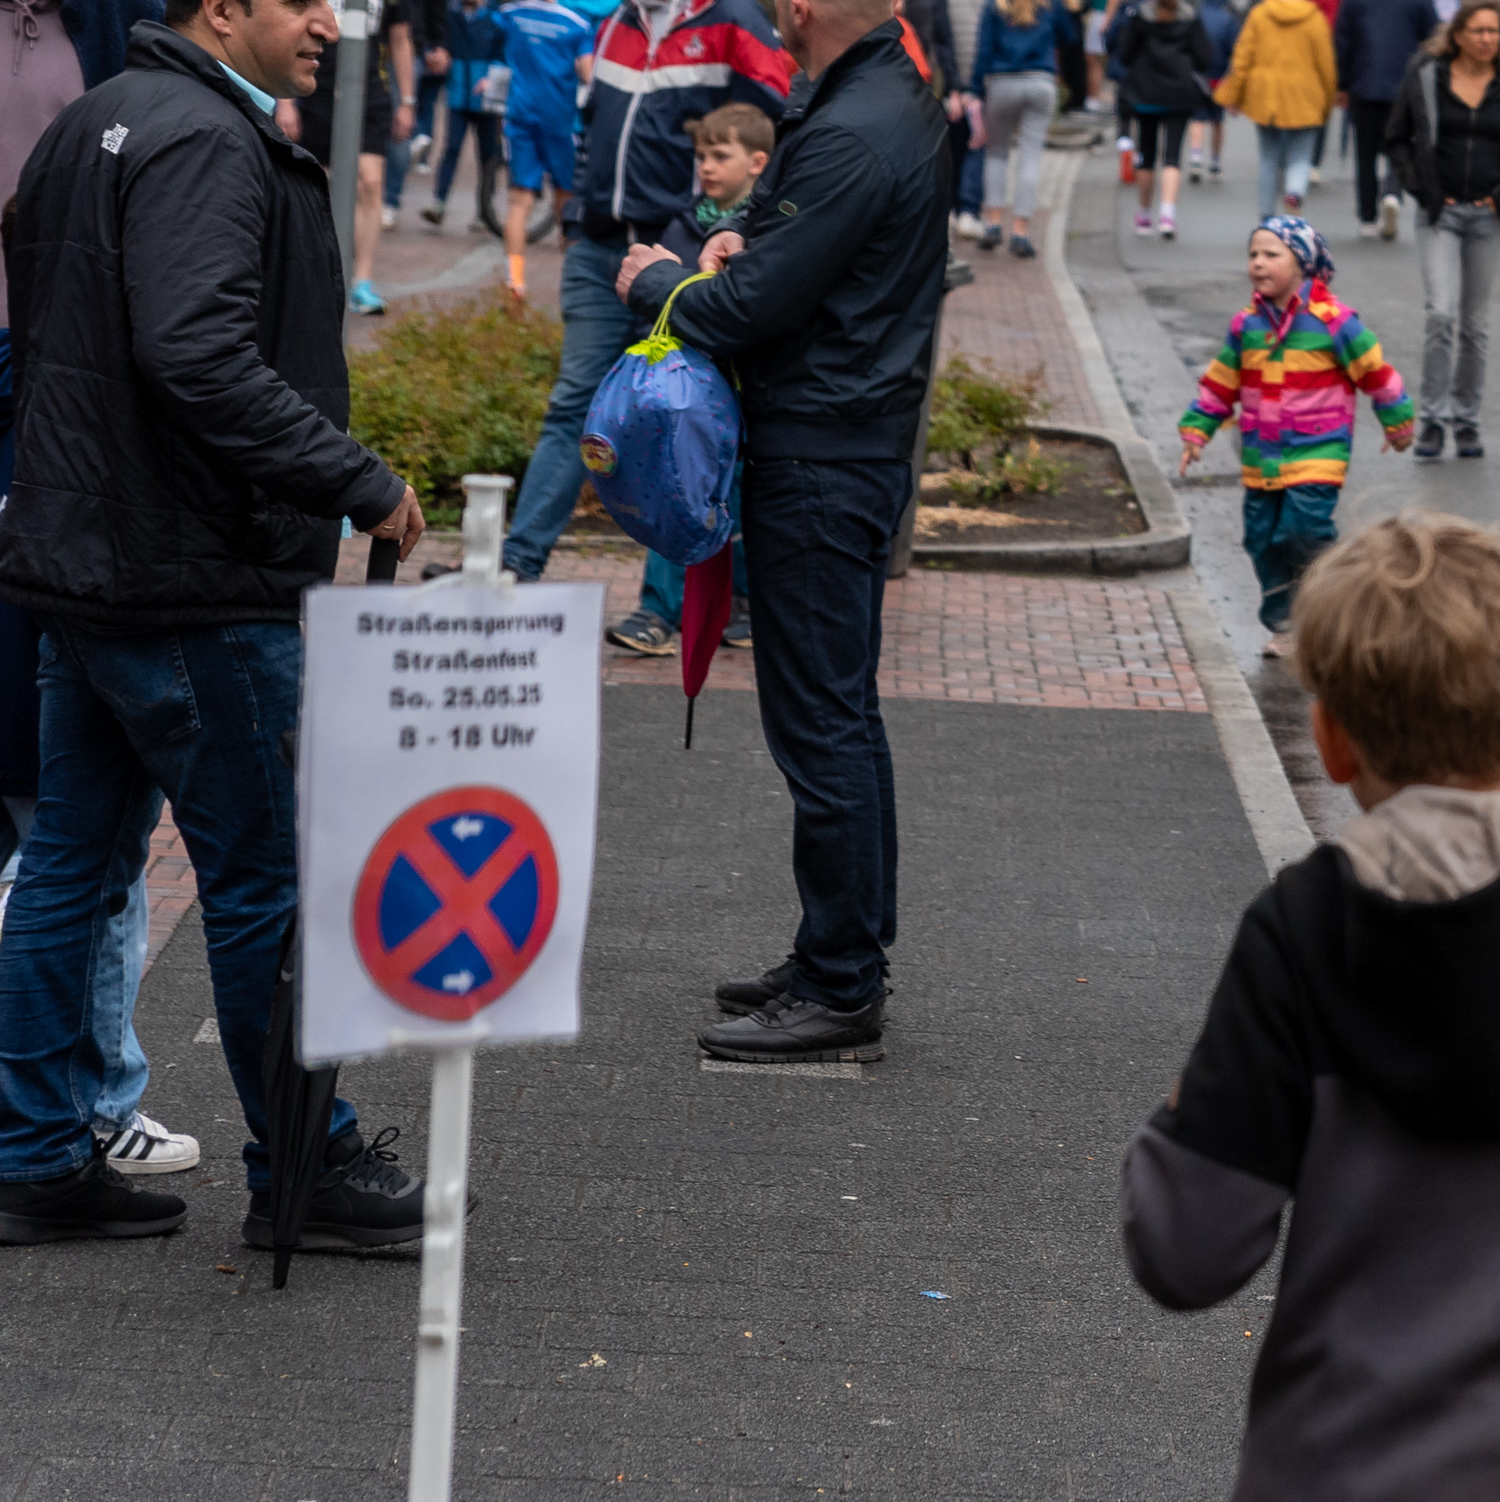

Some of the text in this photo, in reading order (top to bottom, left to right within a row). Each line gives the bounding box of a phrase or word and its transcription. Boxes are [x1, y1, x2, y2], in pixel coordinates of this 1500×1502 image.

[357, 612, 566, 638] Straßensperrung
[393, 648, 537, 672] Straßenfest
[389, 683, 542, 709] So. 25.05.25
[400, 726, 417, 750] 8
[450, 726, 482, 749] 18
[491, 724, 535, 748] Uhr
